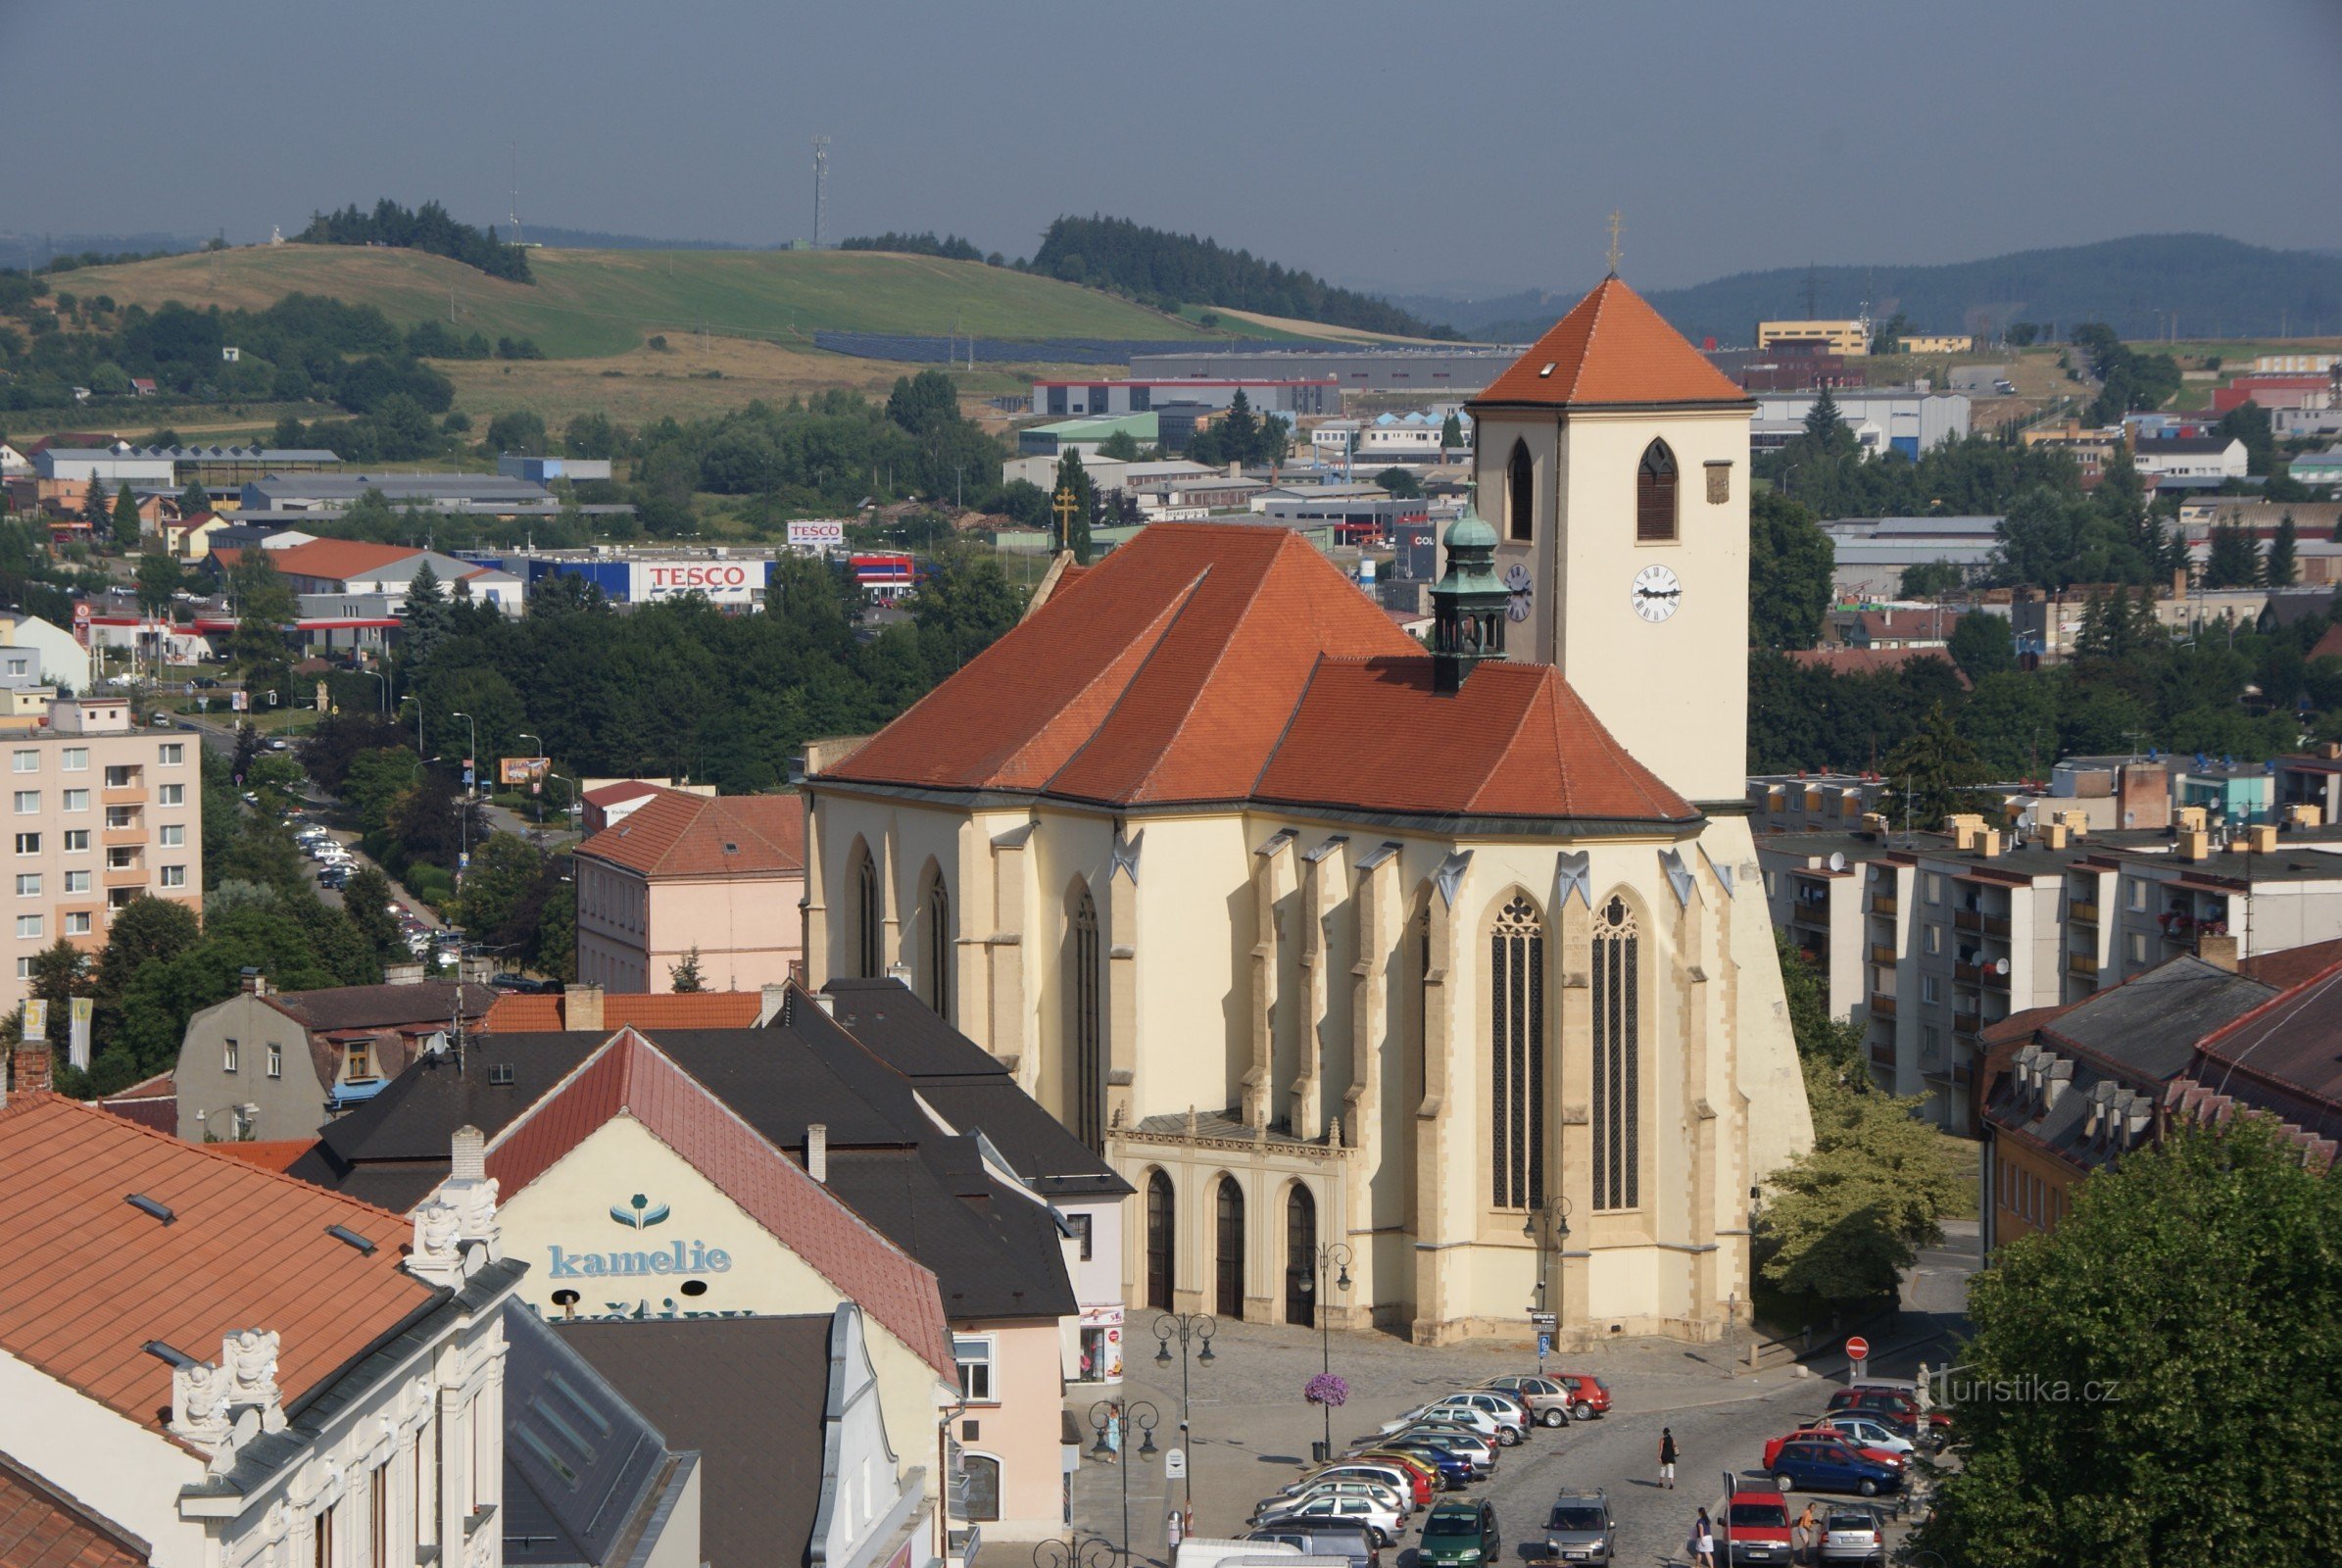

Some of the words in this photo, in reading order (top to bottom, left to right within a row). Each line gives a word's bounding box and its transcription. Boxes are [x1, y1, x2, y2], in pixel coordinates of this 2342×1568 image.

[790, 525, 840, 536] TESCO
[649, 566, 746, 586] TESCO
[25, 1001, 40, 1027] 5
[547, 1240, 733, 1279] kamelie
